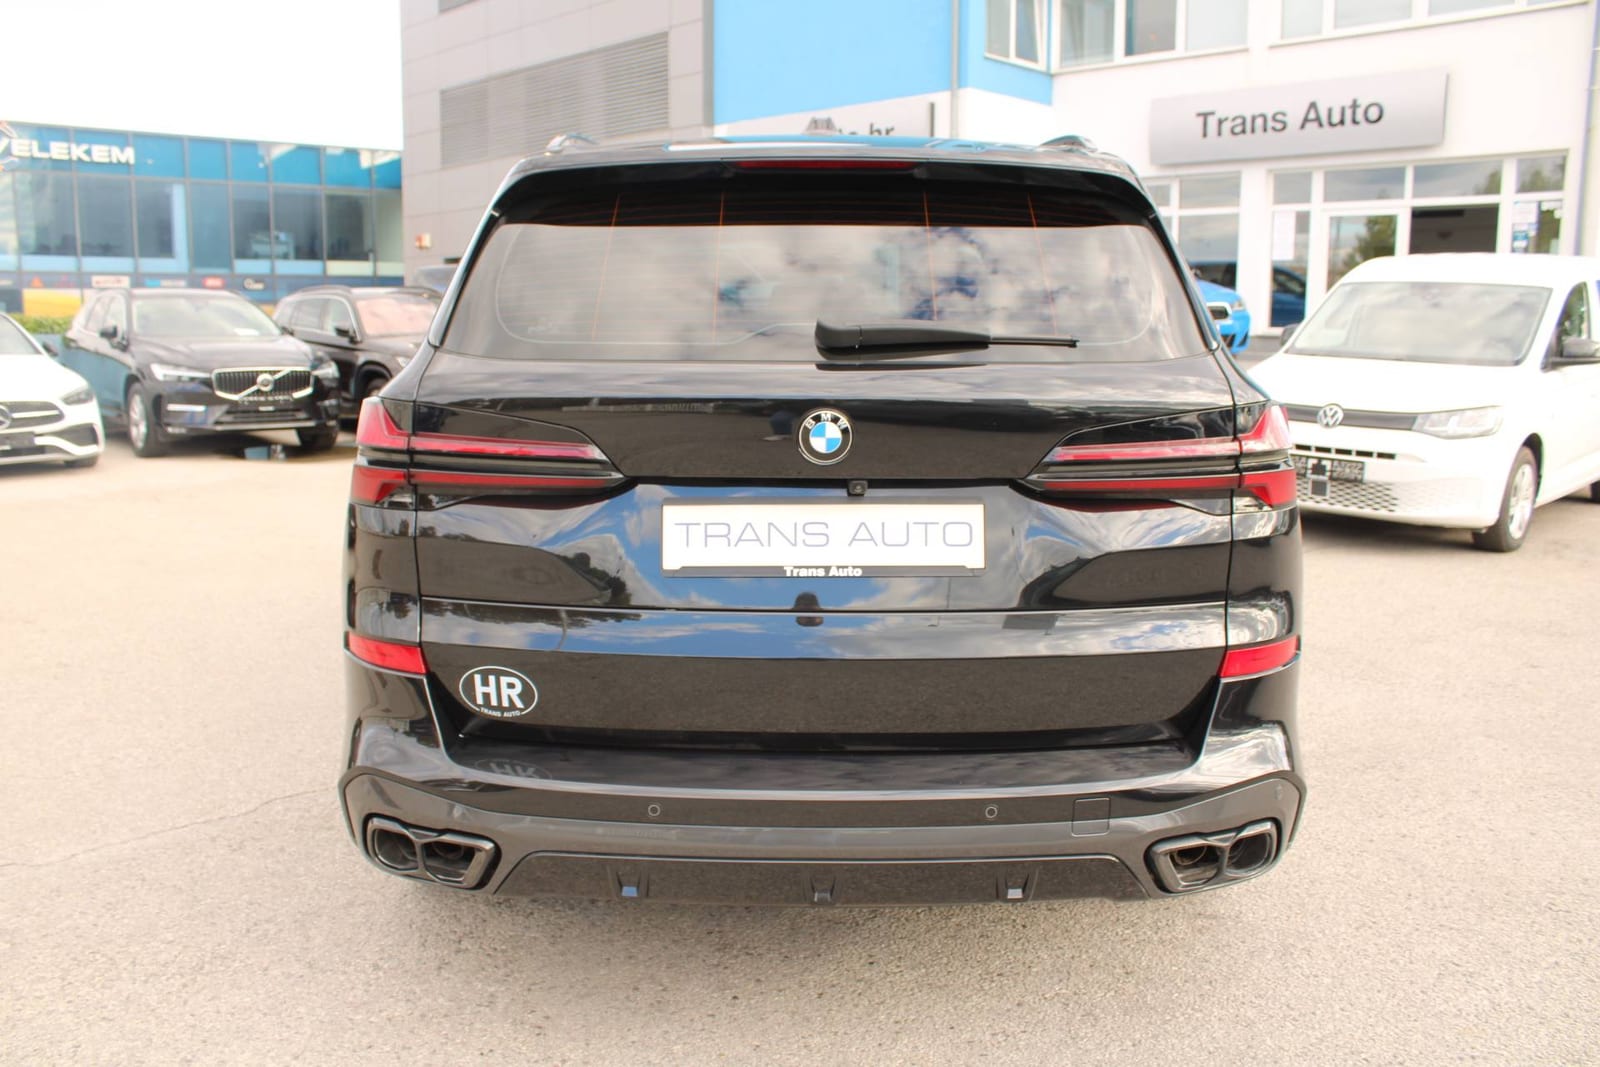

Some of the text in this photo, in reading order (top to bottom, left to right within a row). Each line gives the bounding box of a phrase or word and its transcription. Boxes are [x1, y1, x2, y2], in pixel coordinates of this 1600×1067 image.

[1196, 98, 1385, 138] Trans Auto
[804, 412, 848, 430] BMW
[674, 521, 973, 548] TRANS AUTO
[784, 565, 863, 577] Trans Auto
[473, 674, 525, 708] HR
[480, 707, 502, 717] TRANS
